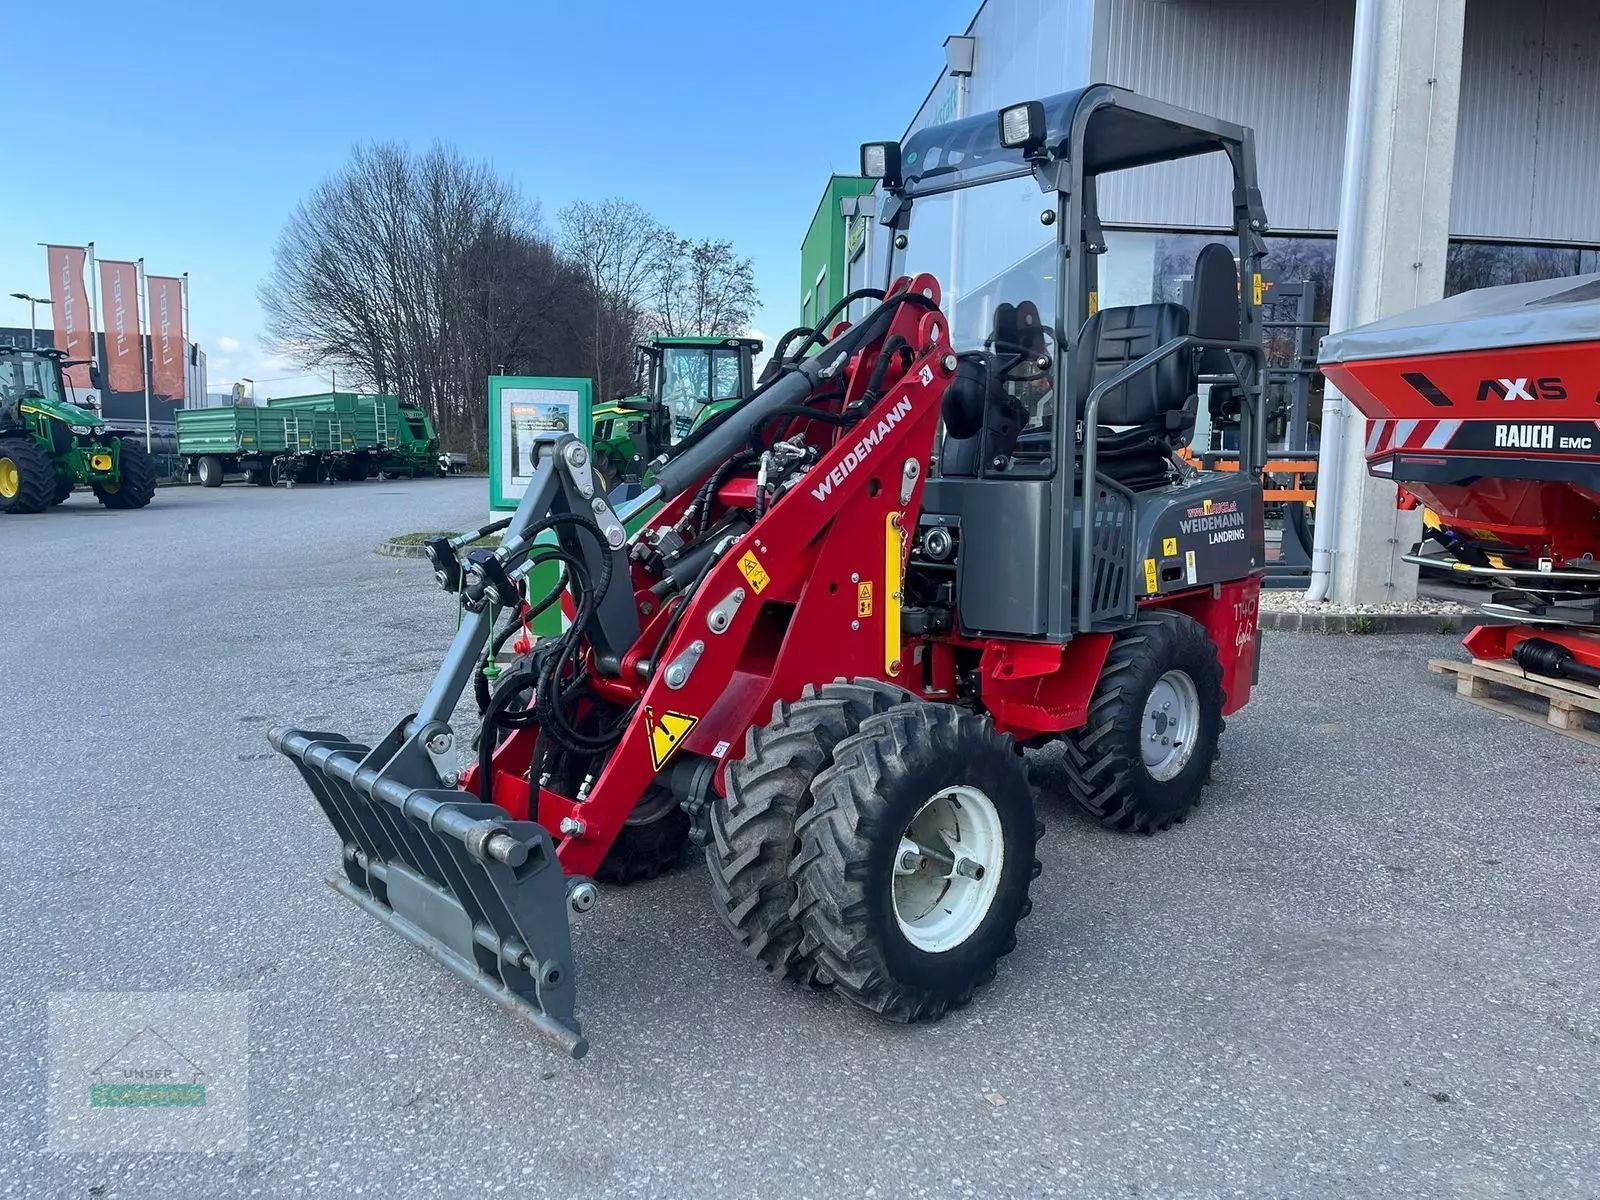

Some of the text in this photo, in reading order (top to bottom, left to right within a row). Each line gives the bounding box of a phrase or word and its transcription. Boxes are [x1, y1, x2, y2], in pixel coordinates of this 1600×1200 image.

[1475, 377, 1568, 401] AXIS
[811, 394, 913, 502] WEIDEMANN
[1495, 424, 1592, 449] RAUCH EMC
[1179, 511, 1245, 535] WEIDEMANN
[1208, 528, 1245, 545] LANDRING
[1233, 599, 1256, 621] 1140
